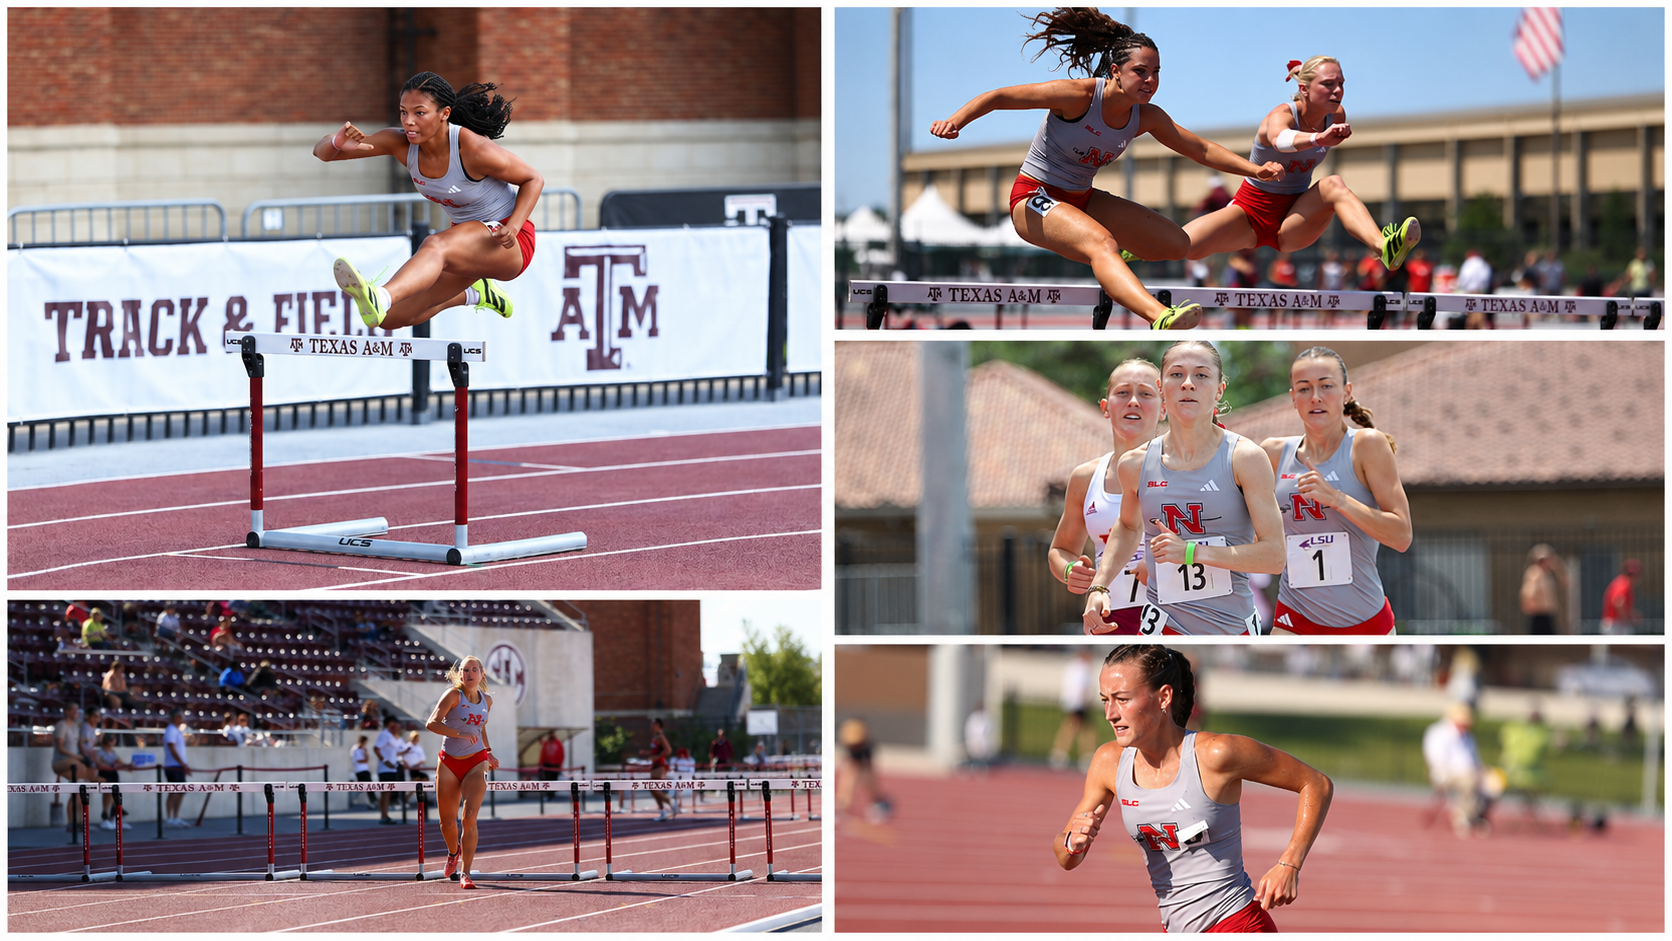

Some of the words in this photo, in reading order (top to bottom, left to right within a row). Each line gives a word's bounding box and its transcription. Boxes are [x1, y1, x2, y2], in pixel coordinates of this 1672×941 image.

[949, 288, 1003, 303] TEXAS
[1008, 289, 1042, 304] A&M
[1235, 293, 1289, 308] TEXAS
[1292, 294, 1322, 308] A&M
[1481, 299, 1527, 313] TEXAS
[1530, 300, 1559, 314] A&M
[45, 297, 208, 362] TRACK
[274, 291, 393, 338] FIEL
[309, 338, 358, 355] TEXAS
[361, 340, 394, 357] A&M
[1161, 502, 1206, 535] N
[338, 537, 373, 548] UCS
[1310, 535, 1334, 546] LSU
[1312, 549, 1325, 581] 1
[1177, 563, 1207, 592] 13
[156, 784, 195, 792] TEXAS
[336, 783, 364, 791] TEXAS
[488, 782, 518, 790] TEXAS
[642, 781, 672, 789] TEXAS
[1137, 822, 1181, 852] N
